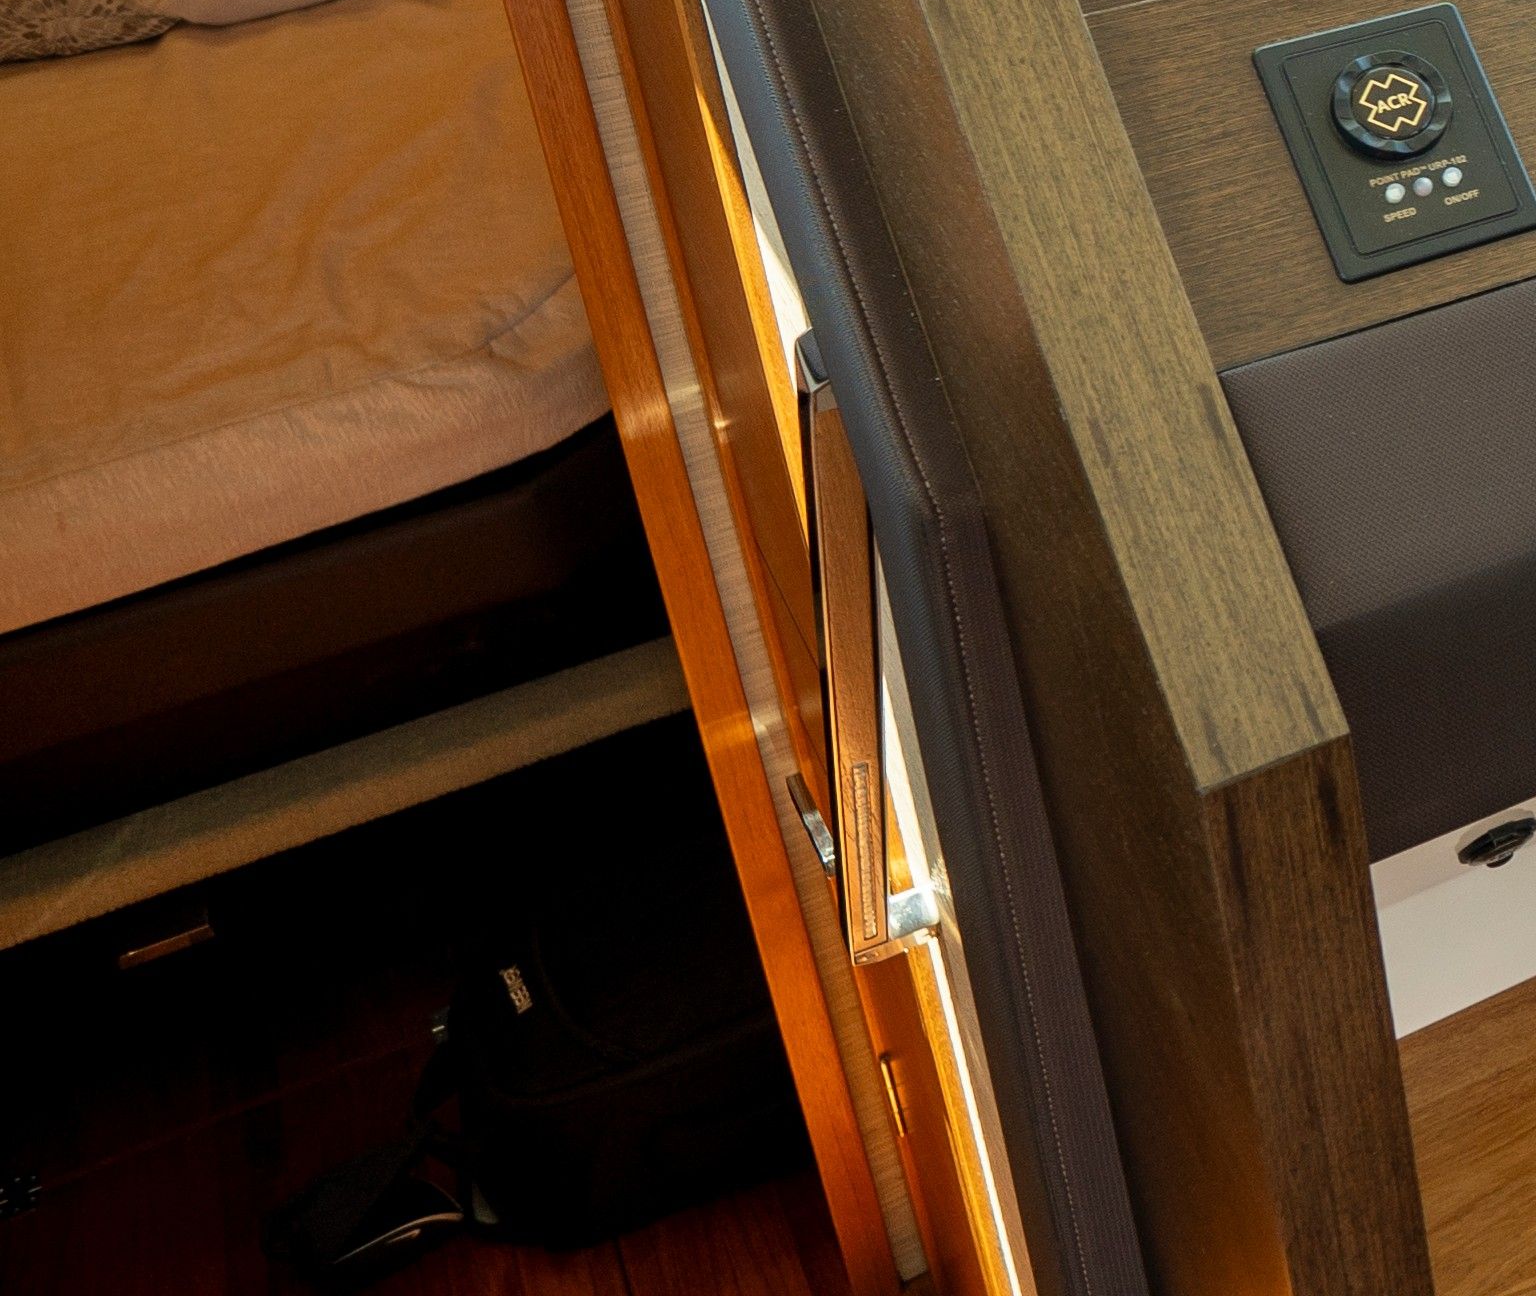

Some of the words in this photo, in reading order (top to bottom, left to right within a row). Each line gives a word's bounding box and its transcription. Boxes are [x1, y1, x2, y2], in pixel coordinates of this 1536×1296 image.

[1377, 93, 1413, 114] ACR
[1369, 172, 1400, 188] POINT
[1444, 188, 1480, 206] ON/OFF
[1383, 207, 1417, 223] SPEED
